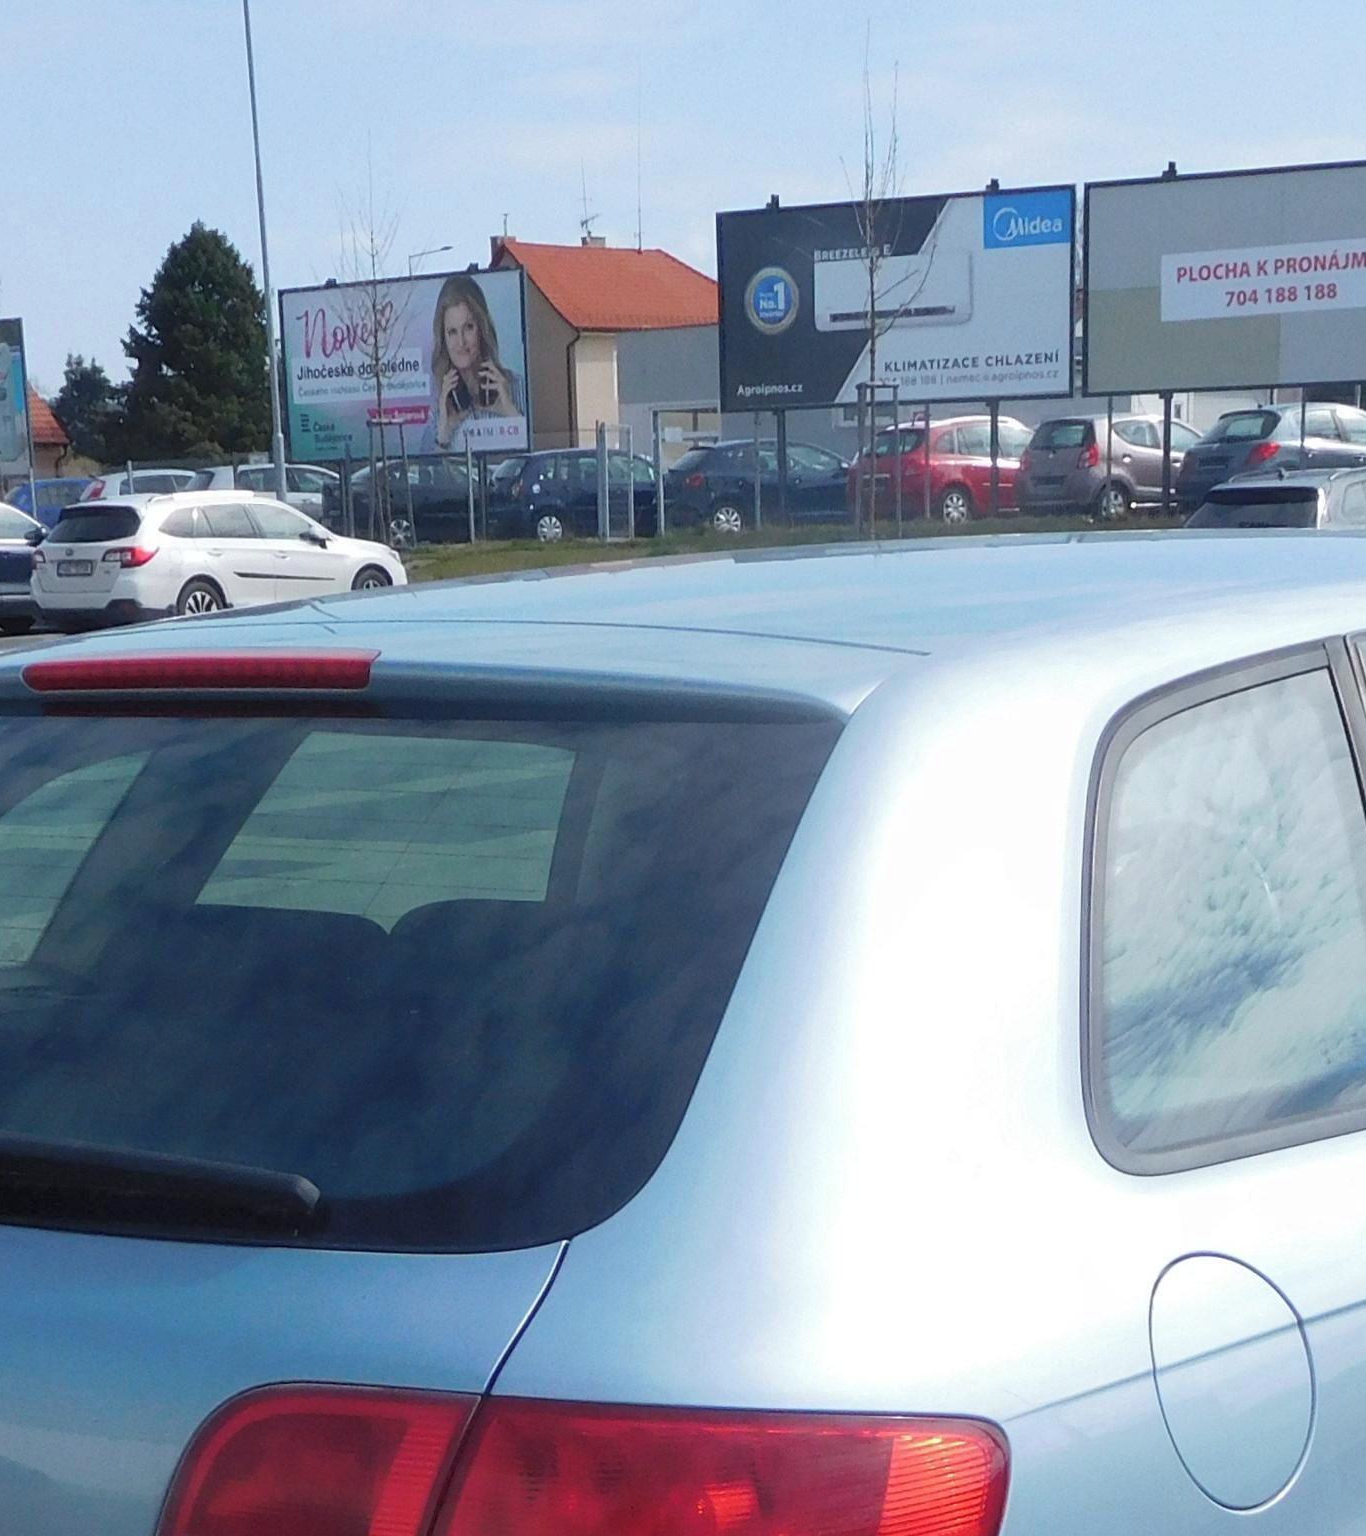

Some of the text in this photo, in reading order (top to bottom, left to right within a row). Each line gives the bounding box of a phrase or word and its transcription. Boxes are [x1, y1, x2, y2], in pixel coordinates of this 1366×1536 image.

[999, 211, 1062, 239] Midea
[1176, 261, 1251, 284] PLOCHA
[1256, 259, 1269, 277] K
[1225, 283, 1338, 307] 704 188 188
[297, 357, 421, 381] Jihočeské dooledne
[885, 349, 1060, 372] KLIMATIZACE CHLAZENÍ
